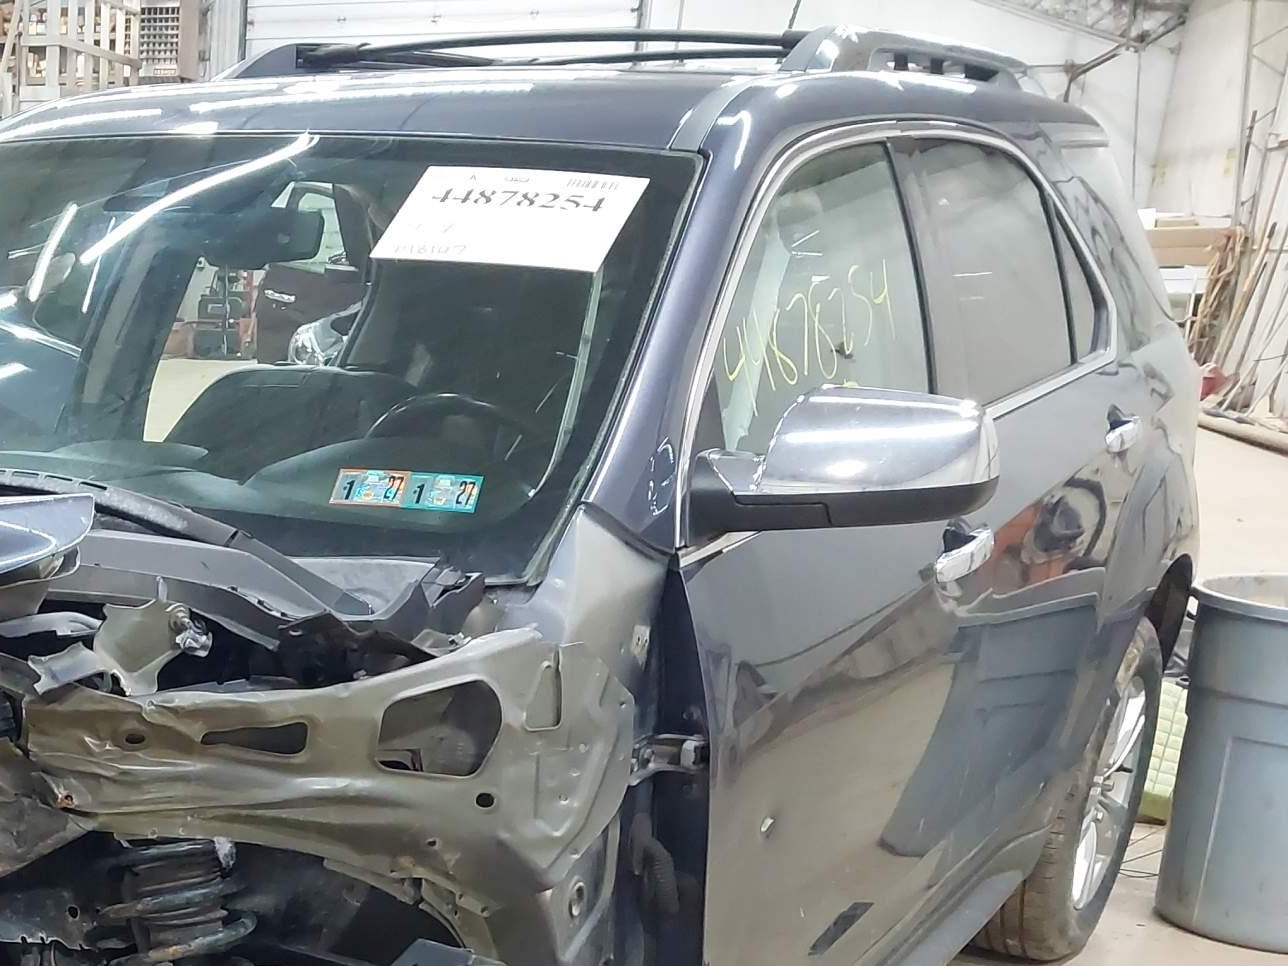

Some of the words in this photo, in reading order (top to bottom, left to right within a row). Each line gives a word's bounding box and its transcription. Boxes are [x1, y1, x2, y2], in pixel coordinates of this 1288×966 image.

[431, 186, 607, 213] 44878254
[383, 475, 405, 502] 27
[455, 480, 477, 506] 27
